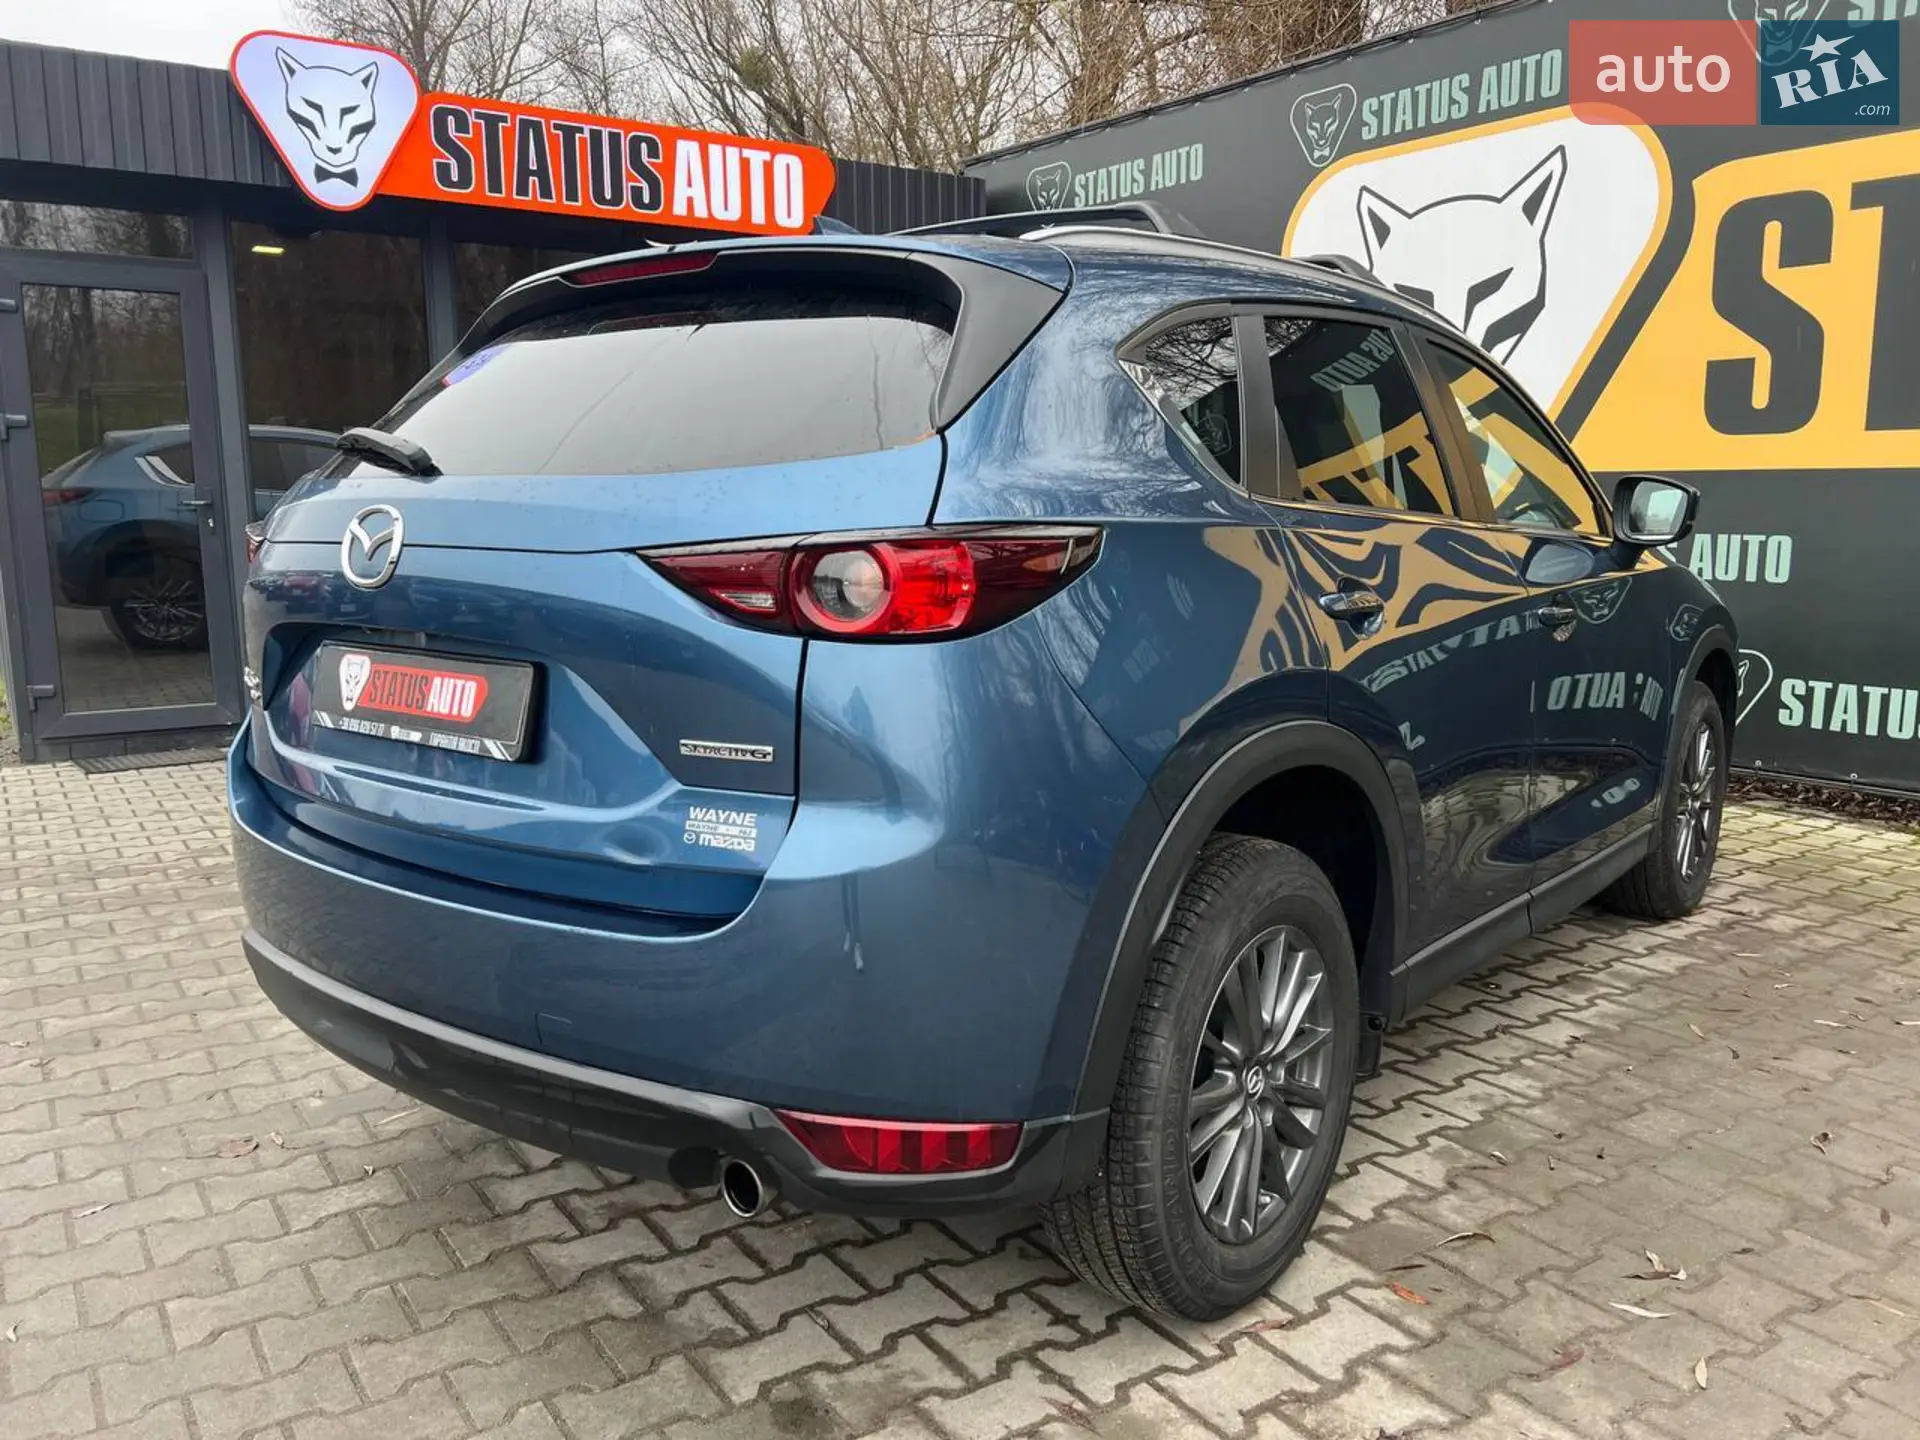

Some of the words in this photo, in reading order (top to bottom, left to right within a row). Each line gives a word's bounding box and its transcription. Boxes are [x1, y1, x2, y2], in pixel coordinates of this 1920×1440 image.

[1361, 73, 1470, 140] STATUS
[1478, 49, 1563, 114] AUTO
[432, 104, 664, 212] STATUS
[672, 138, 804, 228] AUTO
[1074, 157, 1145, 207] STATUS
[1151, 143, 1204, 188] AUTO
[1688, 533, 1793, 584] AUTO
[369, 669, 428, 710] STATUS
[426, 677, 477, 717] AUTO
[1778, 678, 1920, 740] STATU
[689, 806, 757, 827] WAYNE
